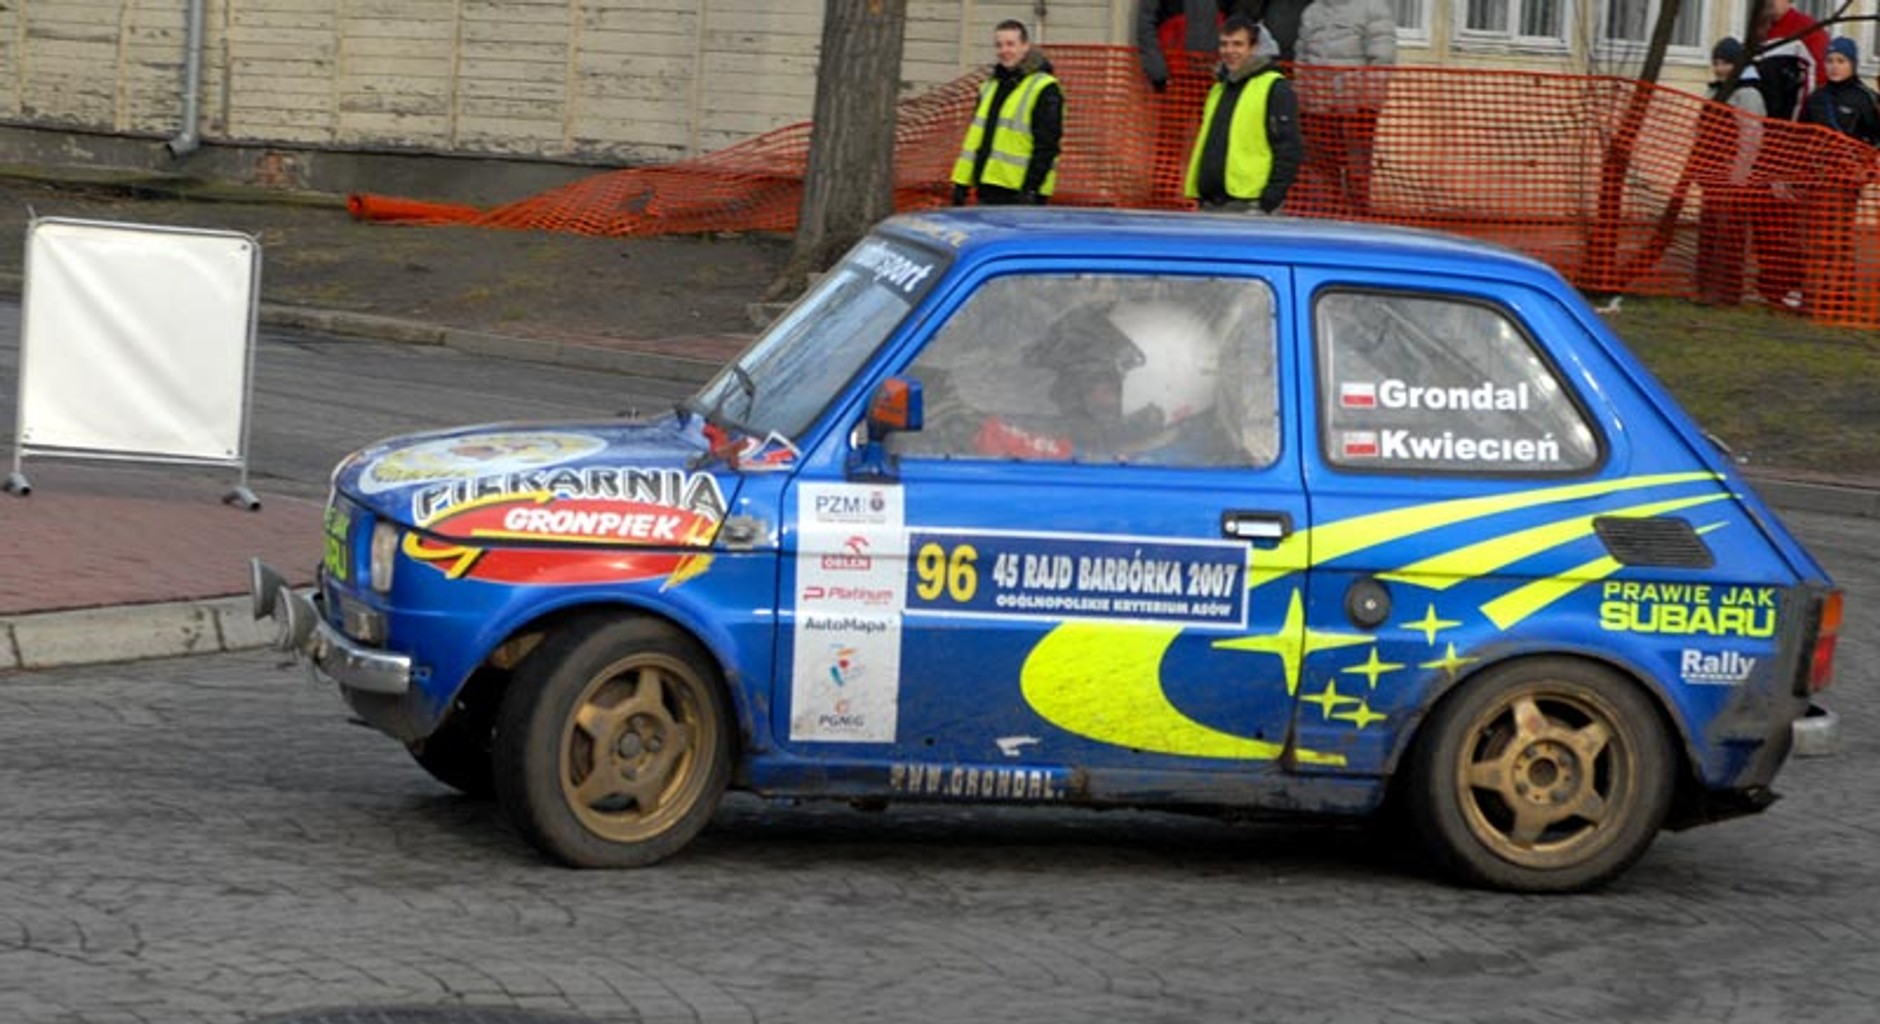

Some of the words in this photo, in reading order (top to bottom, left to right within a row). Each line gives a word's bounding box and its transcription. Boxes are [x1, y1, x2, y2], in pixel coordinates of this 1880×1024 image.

[1379, 379, 1529, 410] Grondal
[1381, 430, 1560, 462] Kwiecień
[411, 466, 727, 527] PIEKARNIA
[816, 495, 860, 513] PZM
[504, 508, 681, 539] GRONPIEK
[916, 543, 978, 602] 96
[993, 553, 1019, 588] 45
[1023, 554, 1073, 591] RAJD
[1077, 549, 1183, 596] BARBÓRKA
[1187, 563, 1238, 598] 2007
[828, 586, 893, 601] Platinum
[1604, 582, 1711, 603] PRAWIE
[1721, 587, 1776, 606] JAK
[805, 618, 886, 634] AutoMapa
[1600, 601, 1776, 637] SUBARU
[1681, 649, 1757, 680] Rally
